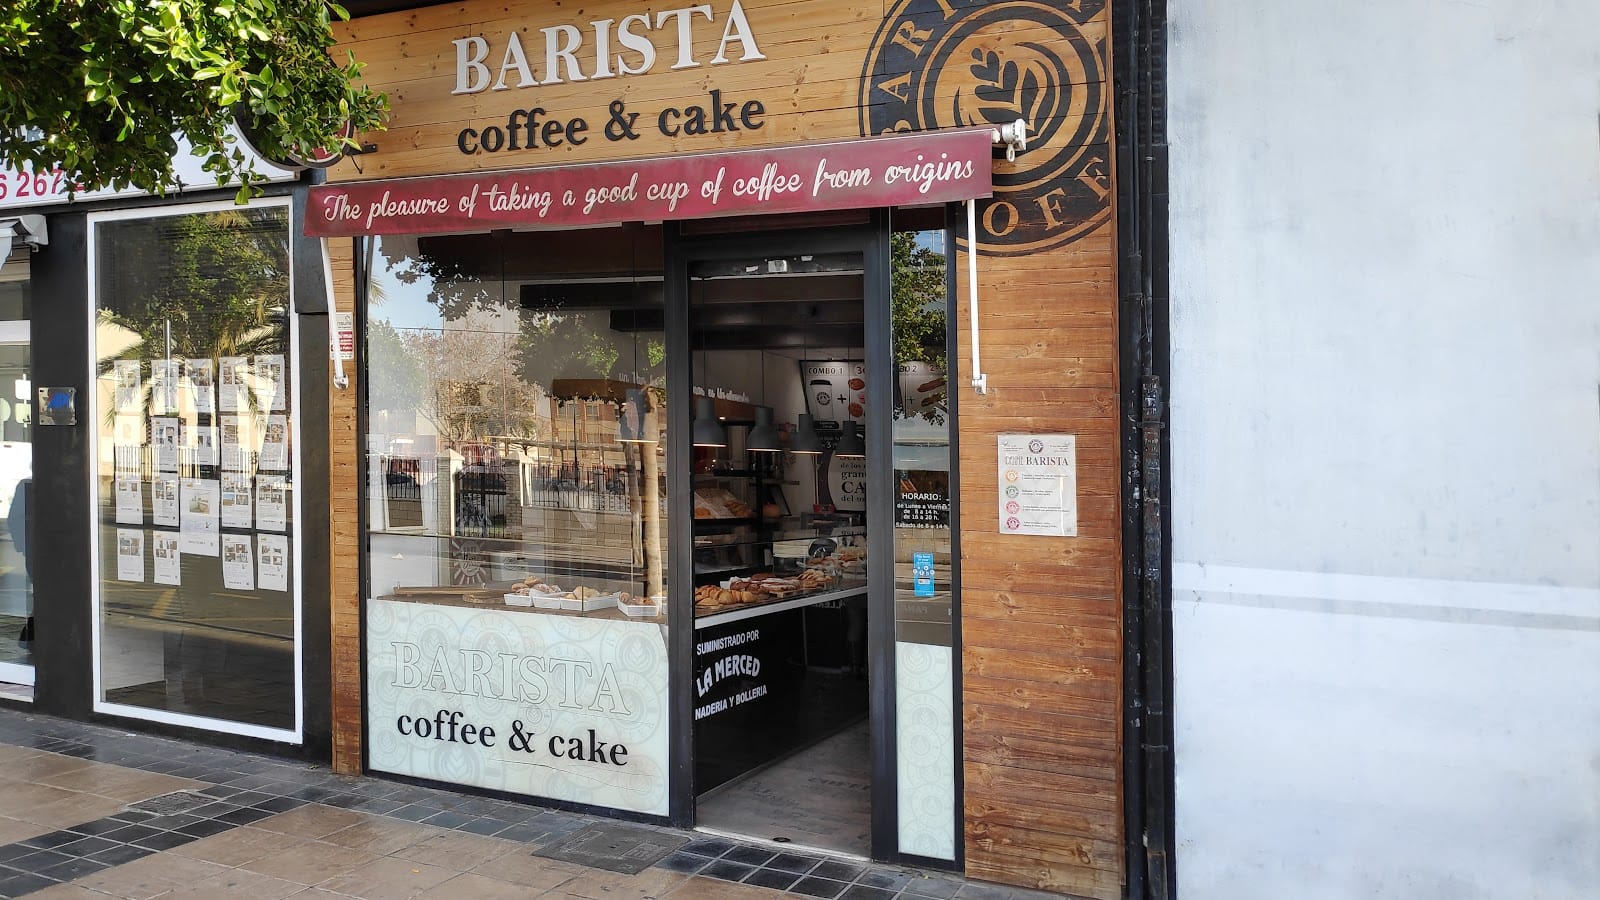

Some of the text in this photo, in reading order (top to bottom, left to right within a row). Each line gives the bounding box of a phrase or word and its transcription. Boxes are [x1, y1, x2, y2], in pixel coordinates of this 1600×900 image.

[451, 0, 767, 95] BARISTA
[457, 89, 765, 155] coffee & cake
[324, 153, 975, 230] The pleasure of taking a good cup of coffee from origins
[808, 367, 836, 375] COMBO
[1026, 456, 1069, 466] BARISTA
[901, 492, 942, 501] HORARIO:
[696, 629, 759, 655] SUMINISTRADO POR
[391, 642, 632, 716] BARISTA
[696, 654, 760, 698] LA MERCED
[729, 695, 735, 707] Y
[735, 684, 768, 705] BOLLERIA
[397, 709, 628, 766] coffee & cake
